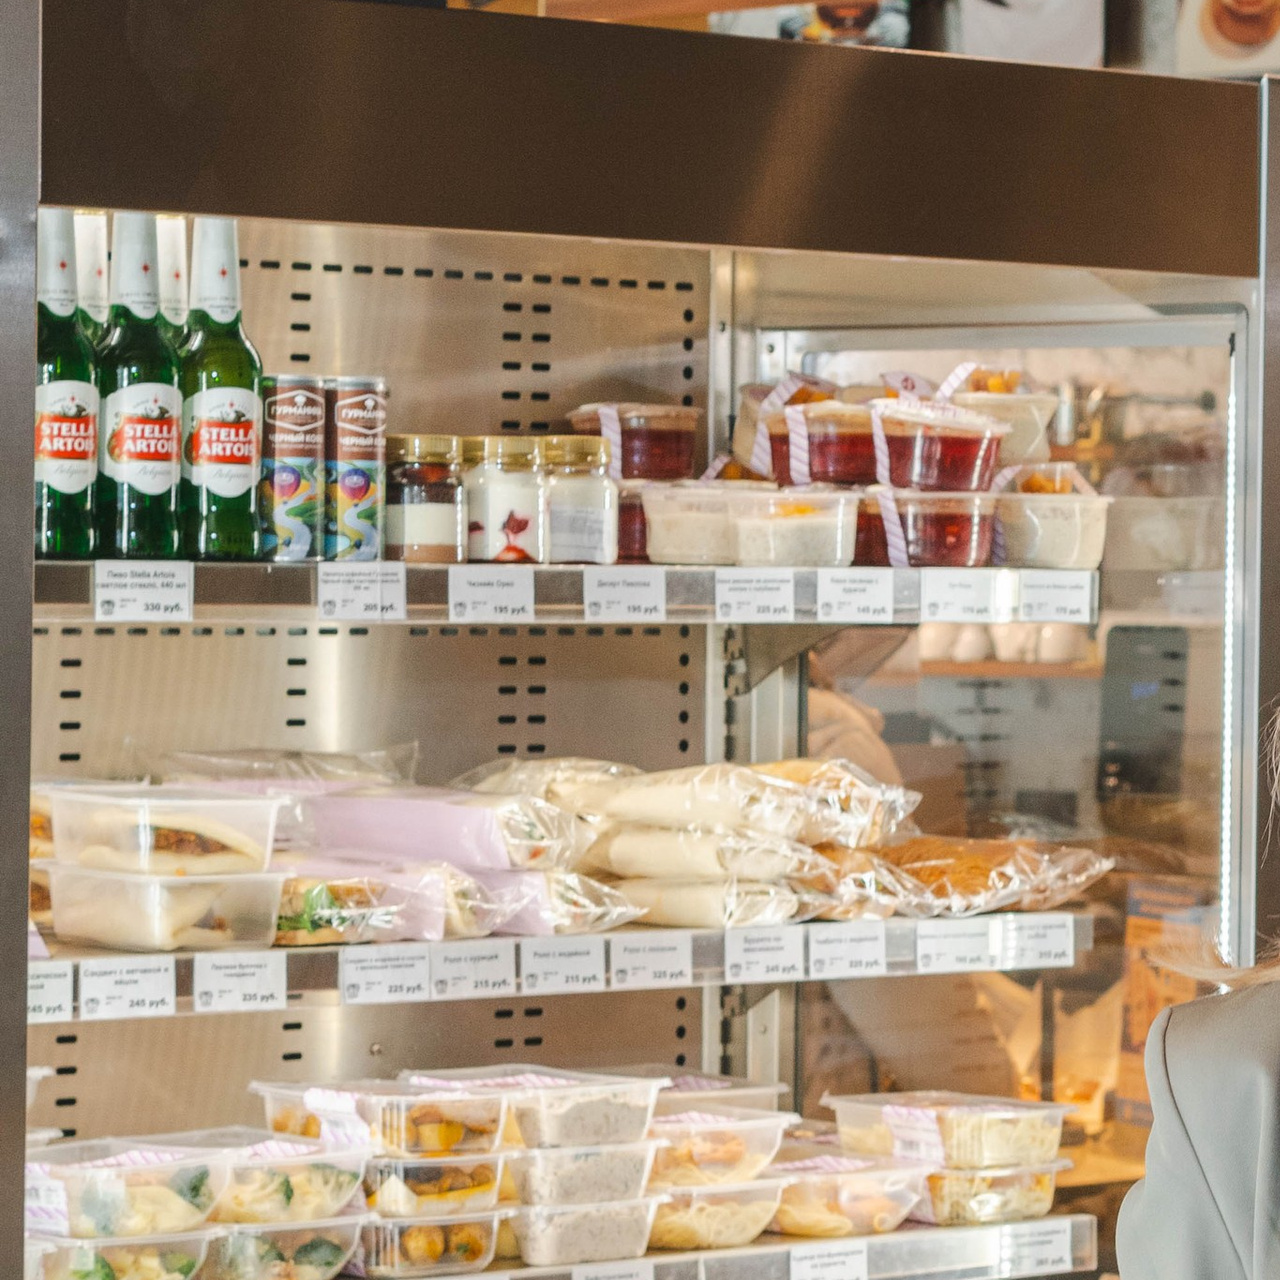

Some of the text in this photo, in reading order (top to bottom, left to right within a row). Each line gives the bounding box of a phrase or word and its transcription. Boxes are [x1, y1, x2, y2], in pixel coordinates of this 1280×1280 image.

[40, 422, 95, 437] STELLA
[124, 424, 177, 438] STELLA
[201, 427, 255, 441] STELLA
[39, 438, 95, 452] ARTOIS
